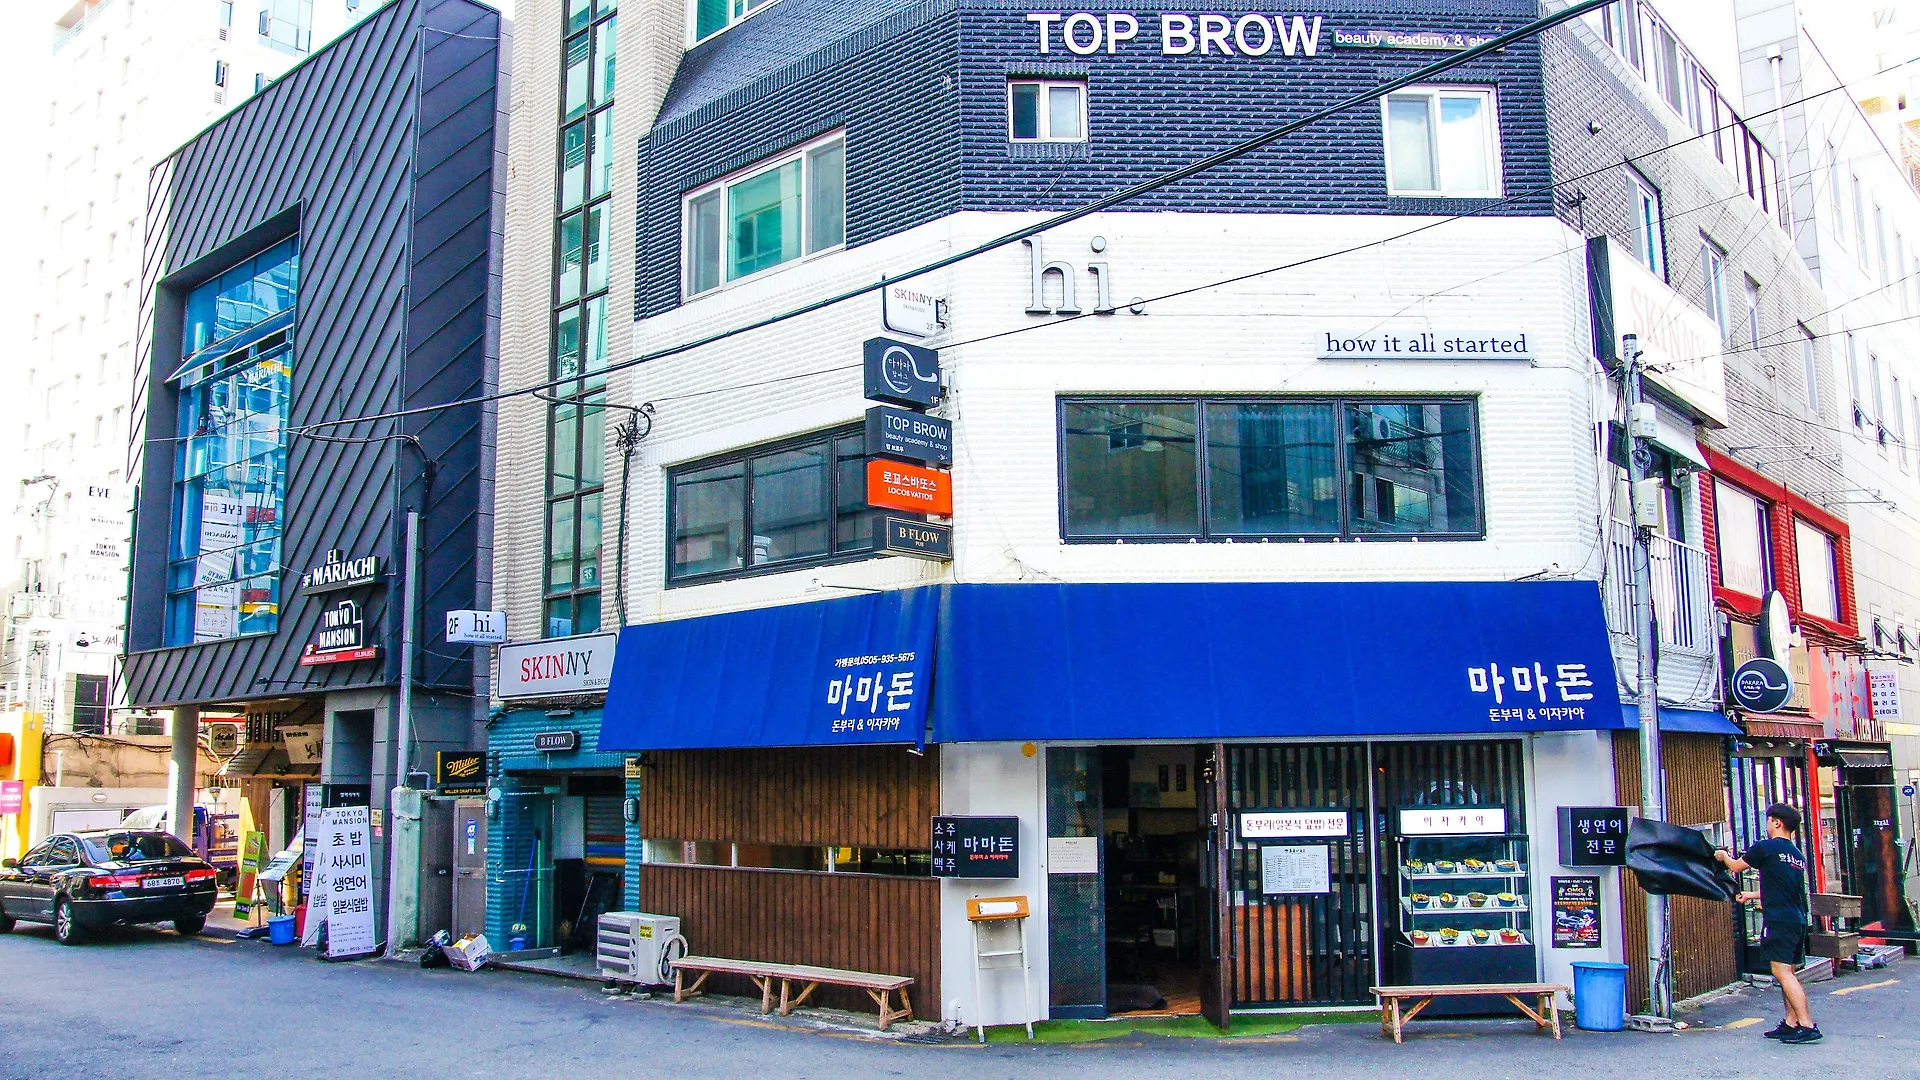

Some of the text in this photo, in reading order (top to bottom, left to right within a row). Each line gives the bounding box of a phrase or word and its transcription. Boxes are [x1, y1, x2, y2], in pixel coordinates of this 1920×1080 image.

[1027, 12, 1324, 57] TOP BROW
[1335, 31, 1493, 48] beauty academy & sho
[1022, 235, 1145, 315] hi.
[894, 288, 932, 306] SKINNY
[1326, 332, 1529, 353] how it all started
[930, 396, 939, 404] 1F
[885, 414, 948, 440] TOP BROW
[885, 432, 904, 442] beauty
[905, 437, 929, 447] academy
[935, 443, 948, 451] shop
[89, 486, 111, 499] EYE
[888, 487, 933, 501] LOCOS VATTOS
[899, 527, 940, 543] B FLOW
[90, 550, 120, 559] MANSION
[95, 543, 116, 551] TOKYO
[327, 549, 340, 564] EL
[302, 575, 312, 588] 3F
[312, 556, 376, 586] MARIACHI
[325, 608, 349, 628] TOKYO
[449, 613, 495, 634] 2F hi.
[320, 628, 355, 648] MANSION
[305, 644, 314, 656] 2F
[520, 650, 593, 682] SKINNY
[1468, 662, 1593, 704] 마마돈
[827, 672, 914, 715] 마마돈
[1489, 707, 1585, 722] 돈부리 & 이자카야
[831, 717, 900, 733] 돈부리 & 이자카야
[540, 735, 567, 746] B FLOW
[446, 757, 480, 774] Miller
[336, 809, 363, 817] TOKYO
[934, 822, 956, 836] 소주
[1327, 818, 1344, 830] 전문
[1577, 819, 1622, 835] 생연어
[934, 840, 956, 855] 사케
[964, 835, 1014, 853] 마마돈
[1586, 839, 1616, 854] 전문
[331, 852, 366, 870] 사시미
[934, 858, 956, 872] 맥주
[163, 877, 180, 886] 4870
[332, 875, 367, 893] 생연어
[332, 897, 368, 914] 일본식덮밥
